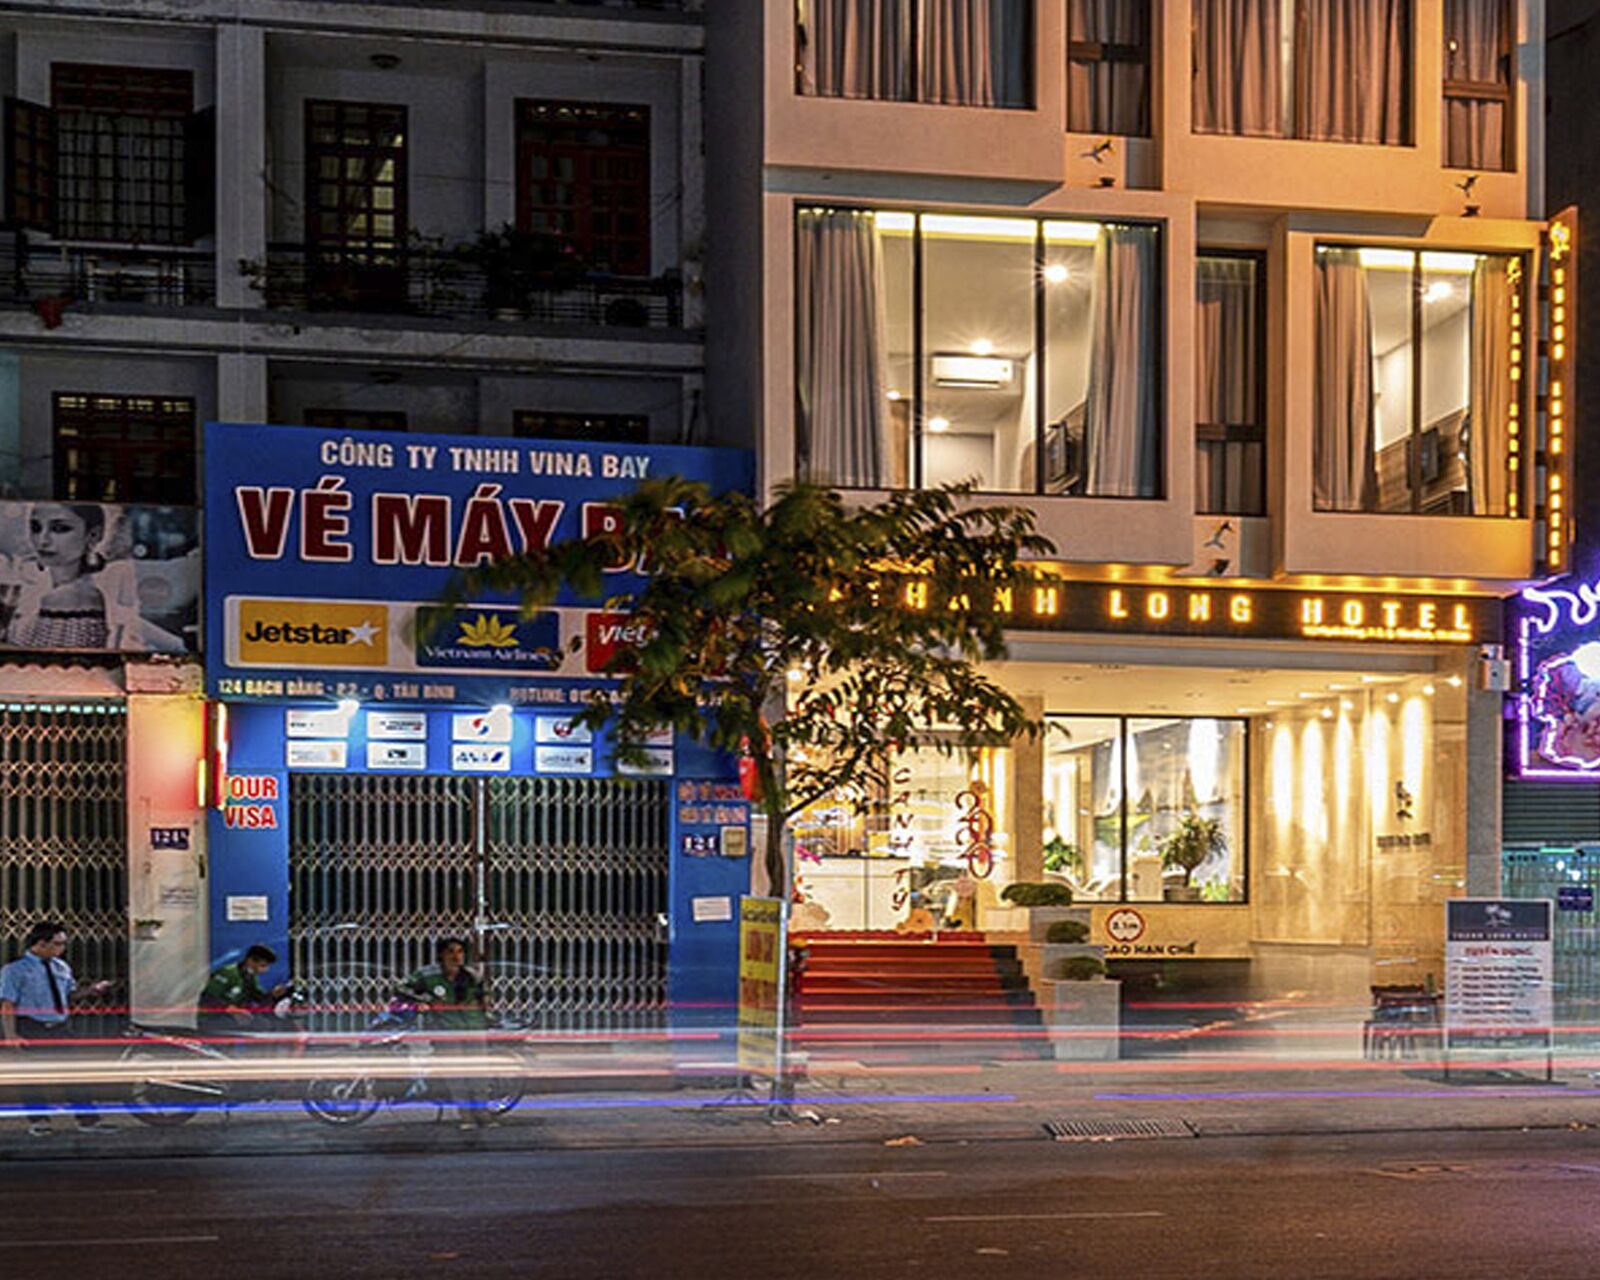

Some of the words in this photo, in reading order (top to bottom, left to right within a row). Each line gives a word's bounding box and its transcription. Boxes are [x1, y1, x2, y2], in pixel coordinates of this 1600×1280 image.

[321, 437, 393, 467] CÔNG
[406, 445, 437, 471] TY
[449, 447, 519, 474] TNHH
[530, 450, 593, 477] VINA
[602, 454, 650, 479] BAY
[236, 476, 352, 562] VÉ
[372, 484, 565, 567] MÁY
[1109, 589, 1253, 623] LONG
[1301, 597, 1471, 630] HOTEL
[246, 621, 350, 644] Jetstar
[424, 645, 493, 660] Vietnam
[218, 679, 242, 693] 124
[224, 805, 278, 828] VISA
